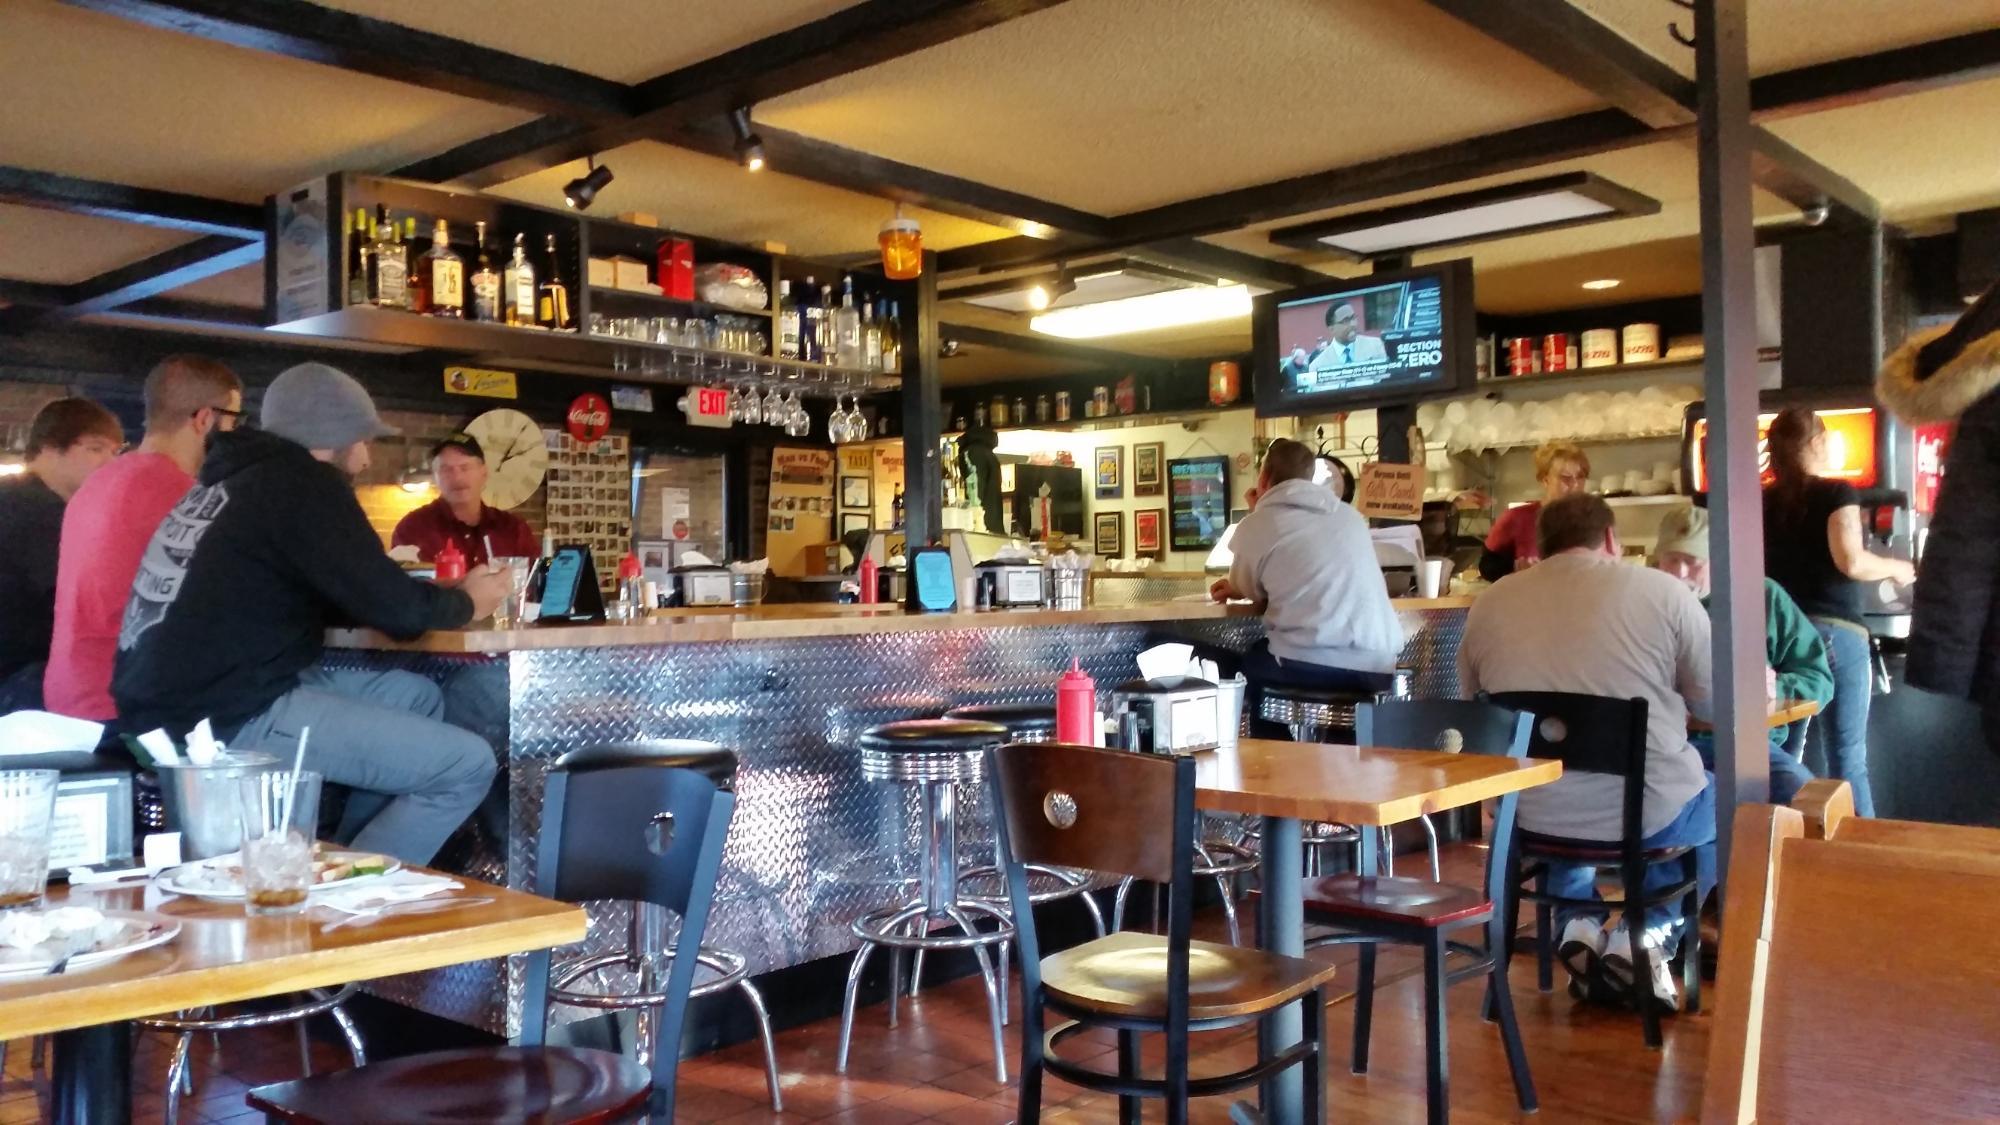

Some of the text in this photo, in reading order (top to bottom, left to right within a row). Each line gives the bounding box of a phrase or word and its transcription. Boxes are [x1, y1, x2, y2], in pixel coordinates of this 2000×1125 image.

[1397, 340, 1441, 354] SECTION
[1397, 352, 1442, 367] ZERO
[699, 389, 727, 416] EXIT
